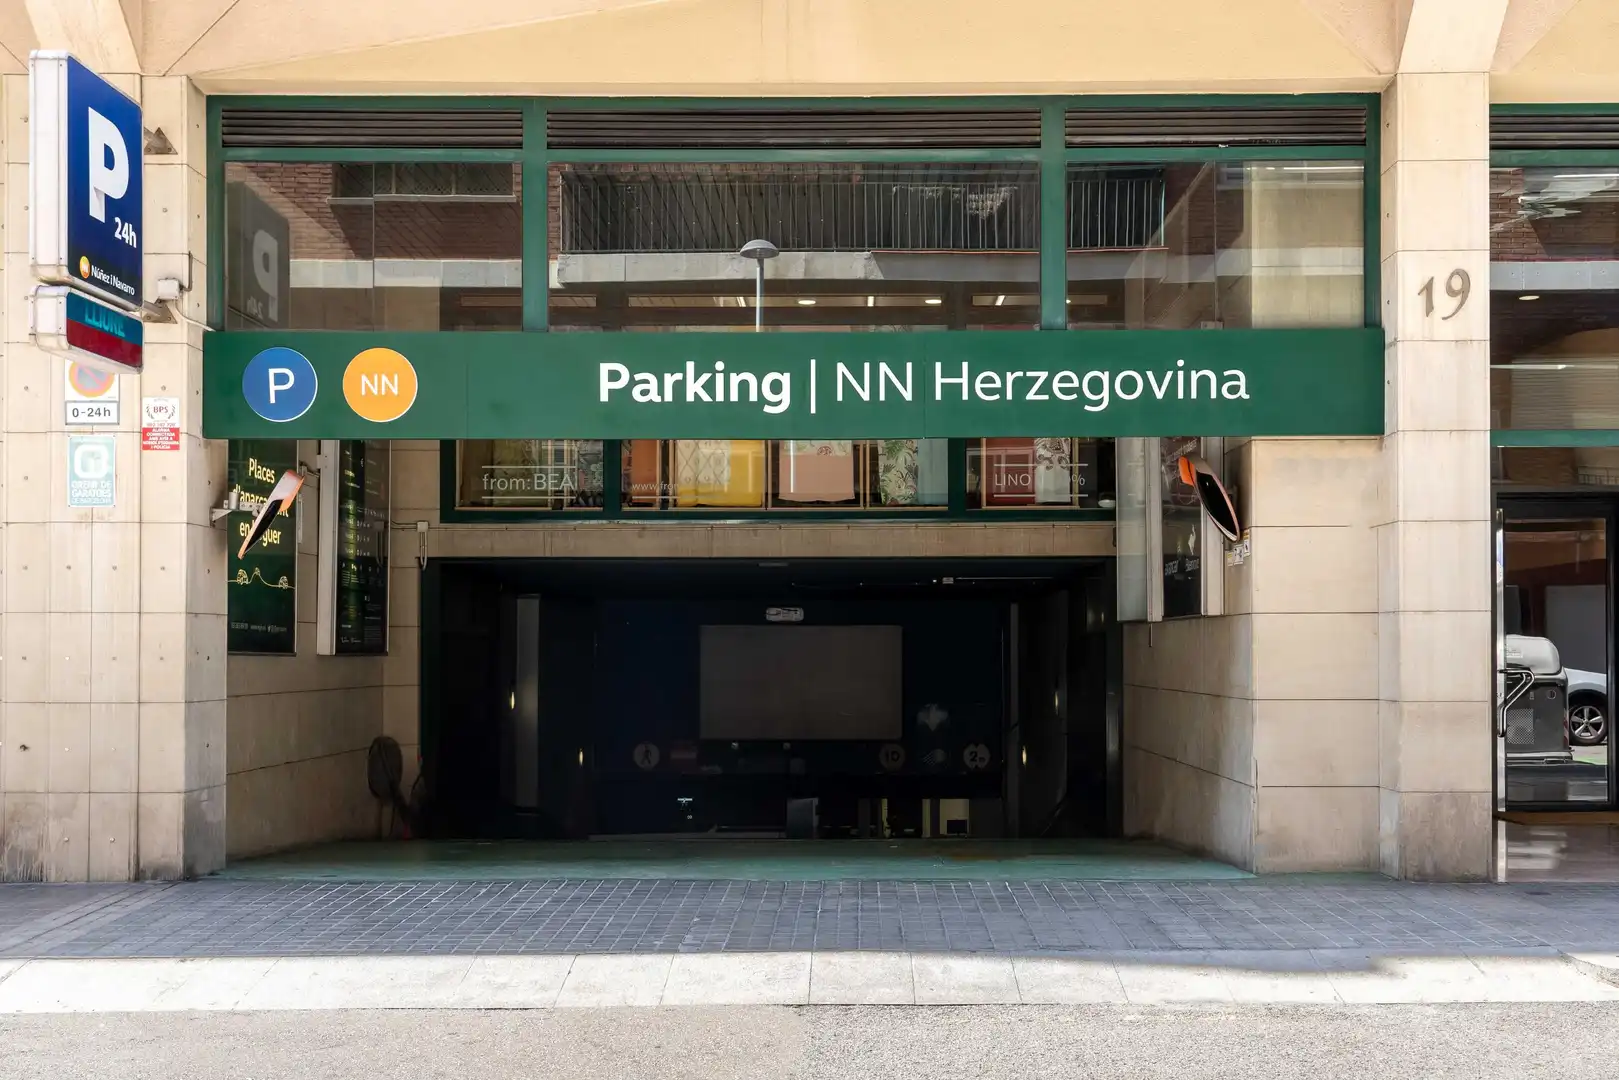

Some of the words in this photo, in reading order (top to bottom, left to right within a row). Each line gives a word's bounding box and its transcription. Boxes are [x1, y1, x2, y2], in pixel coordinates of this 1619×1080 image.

[88, 107, 129, 223] P
[114, 216, 137, 249] 24h
[91, 265, 110, 284] Núñez
[113, 275, 135, 296] Navarro
[1417, 268, 1471, 320] 19
[268, 367, 295, 404] P
[361, 373, 399, 396] NN
[599, 361, 791, 414] Parking
[836, 362, 914, 402] NN
[935, 358, 1250, 412] Herzegovina
[249, 458, 275, 484] Places
[995, 473, 1031, 486] LINO
